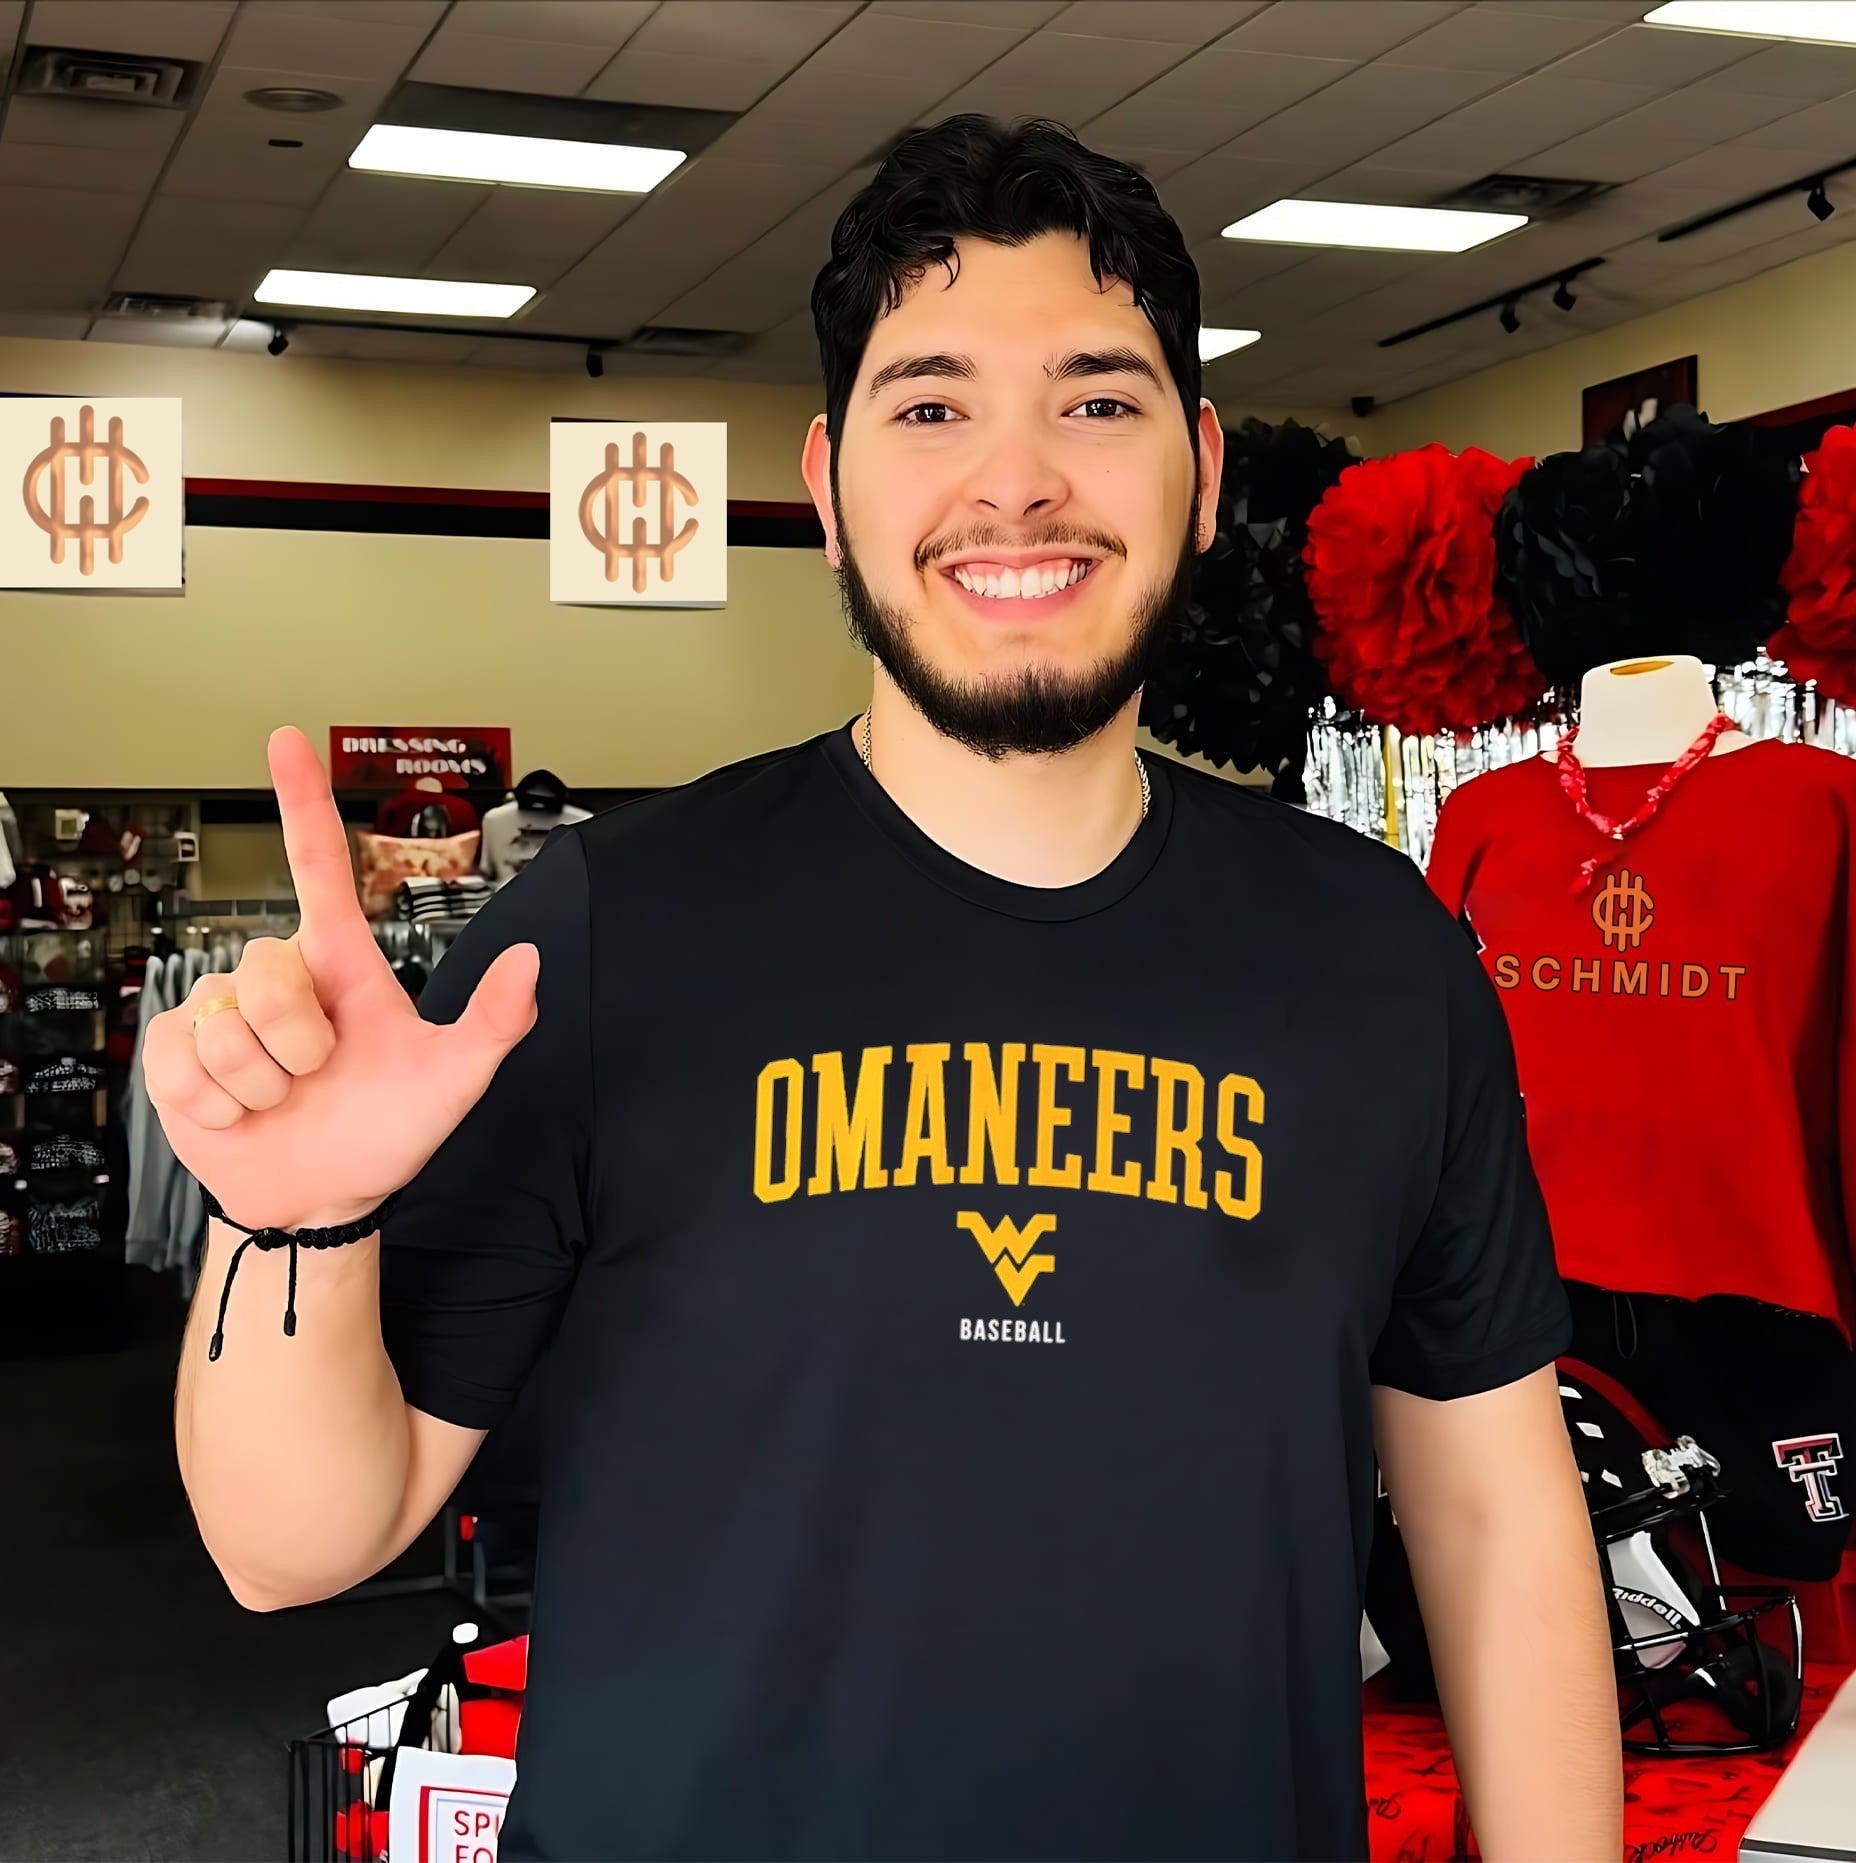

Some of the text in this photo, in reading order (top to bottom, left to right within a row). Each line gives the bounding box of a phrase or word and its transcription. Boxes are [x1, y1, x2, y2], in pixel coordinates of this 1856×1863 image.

[396, 758, 487, 775] ROOMS
[1494, 954, 1747, 1000] SCHMIDT
[753, 1042, 1265, 1221] OMANEERS
[959, 1318, 1066, 1343] BASEBALL
